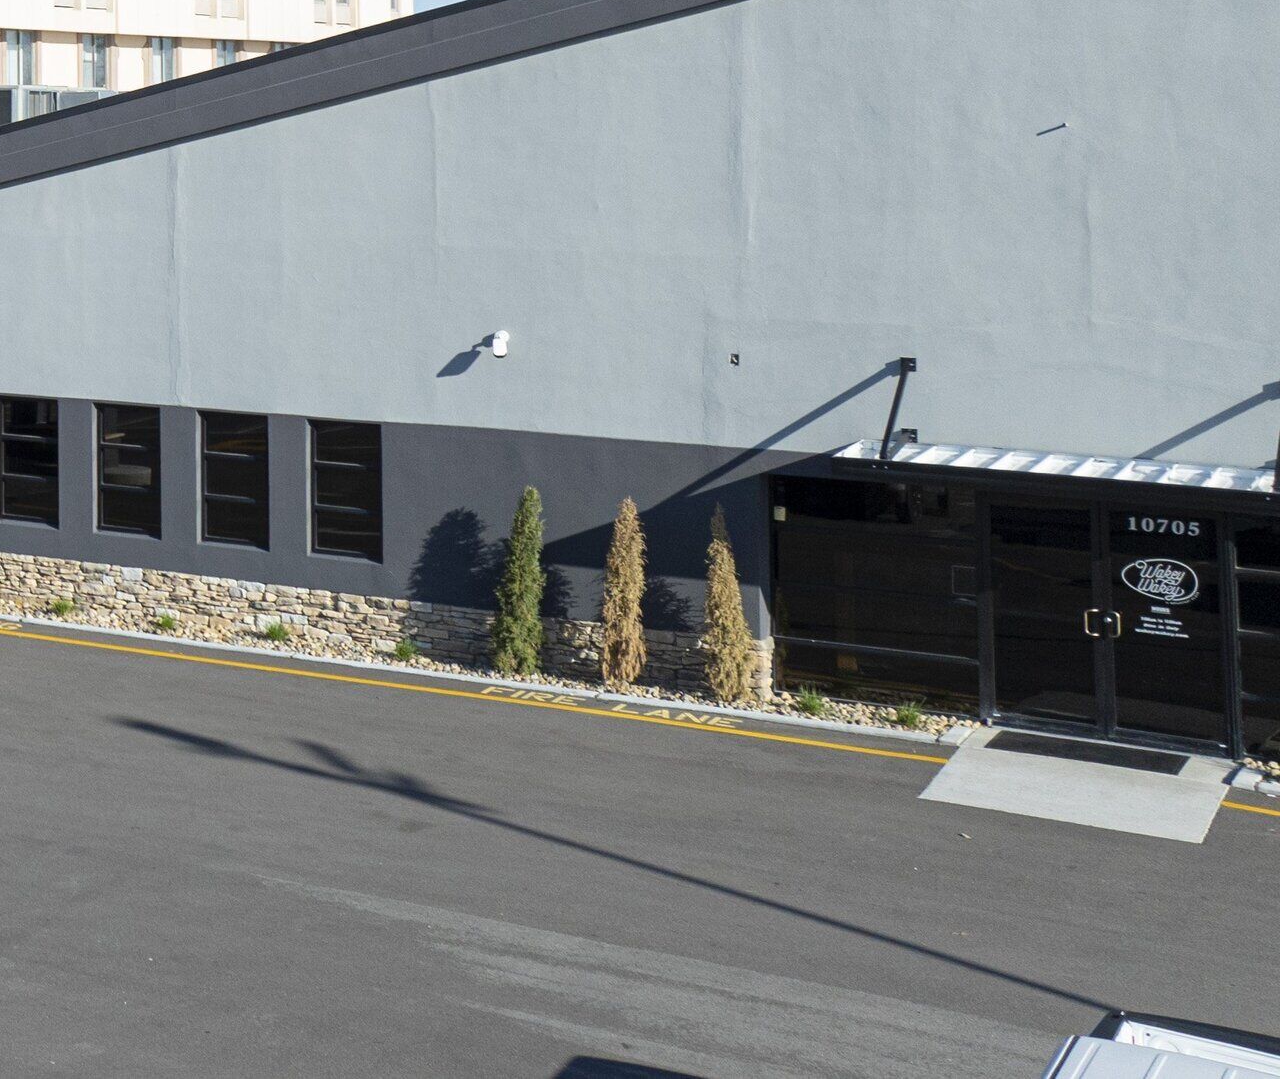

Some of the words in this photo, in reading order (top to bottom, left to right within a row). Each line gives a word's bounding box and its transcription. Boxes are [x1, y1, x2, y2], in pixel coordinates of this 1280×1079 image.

[1128, 516, 1200, 537] 10705
[1135, 560, 1186, 586] Wakey
[1137, 577, 1185, 601] Wakey
[481, 686, 587, 706] FIRE
[611, 703, 743, 728] LANE
